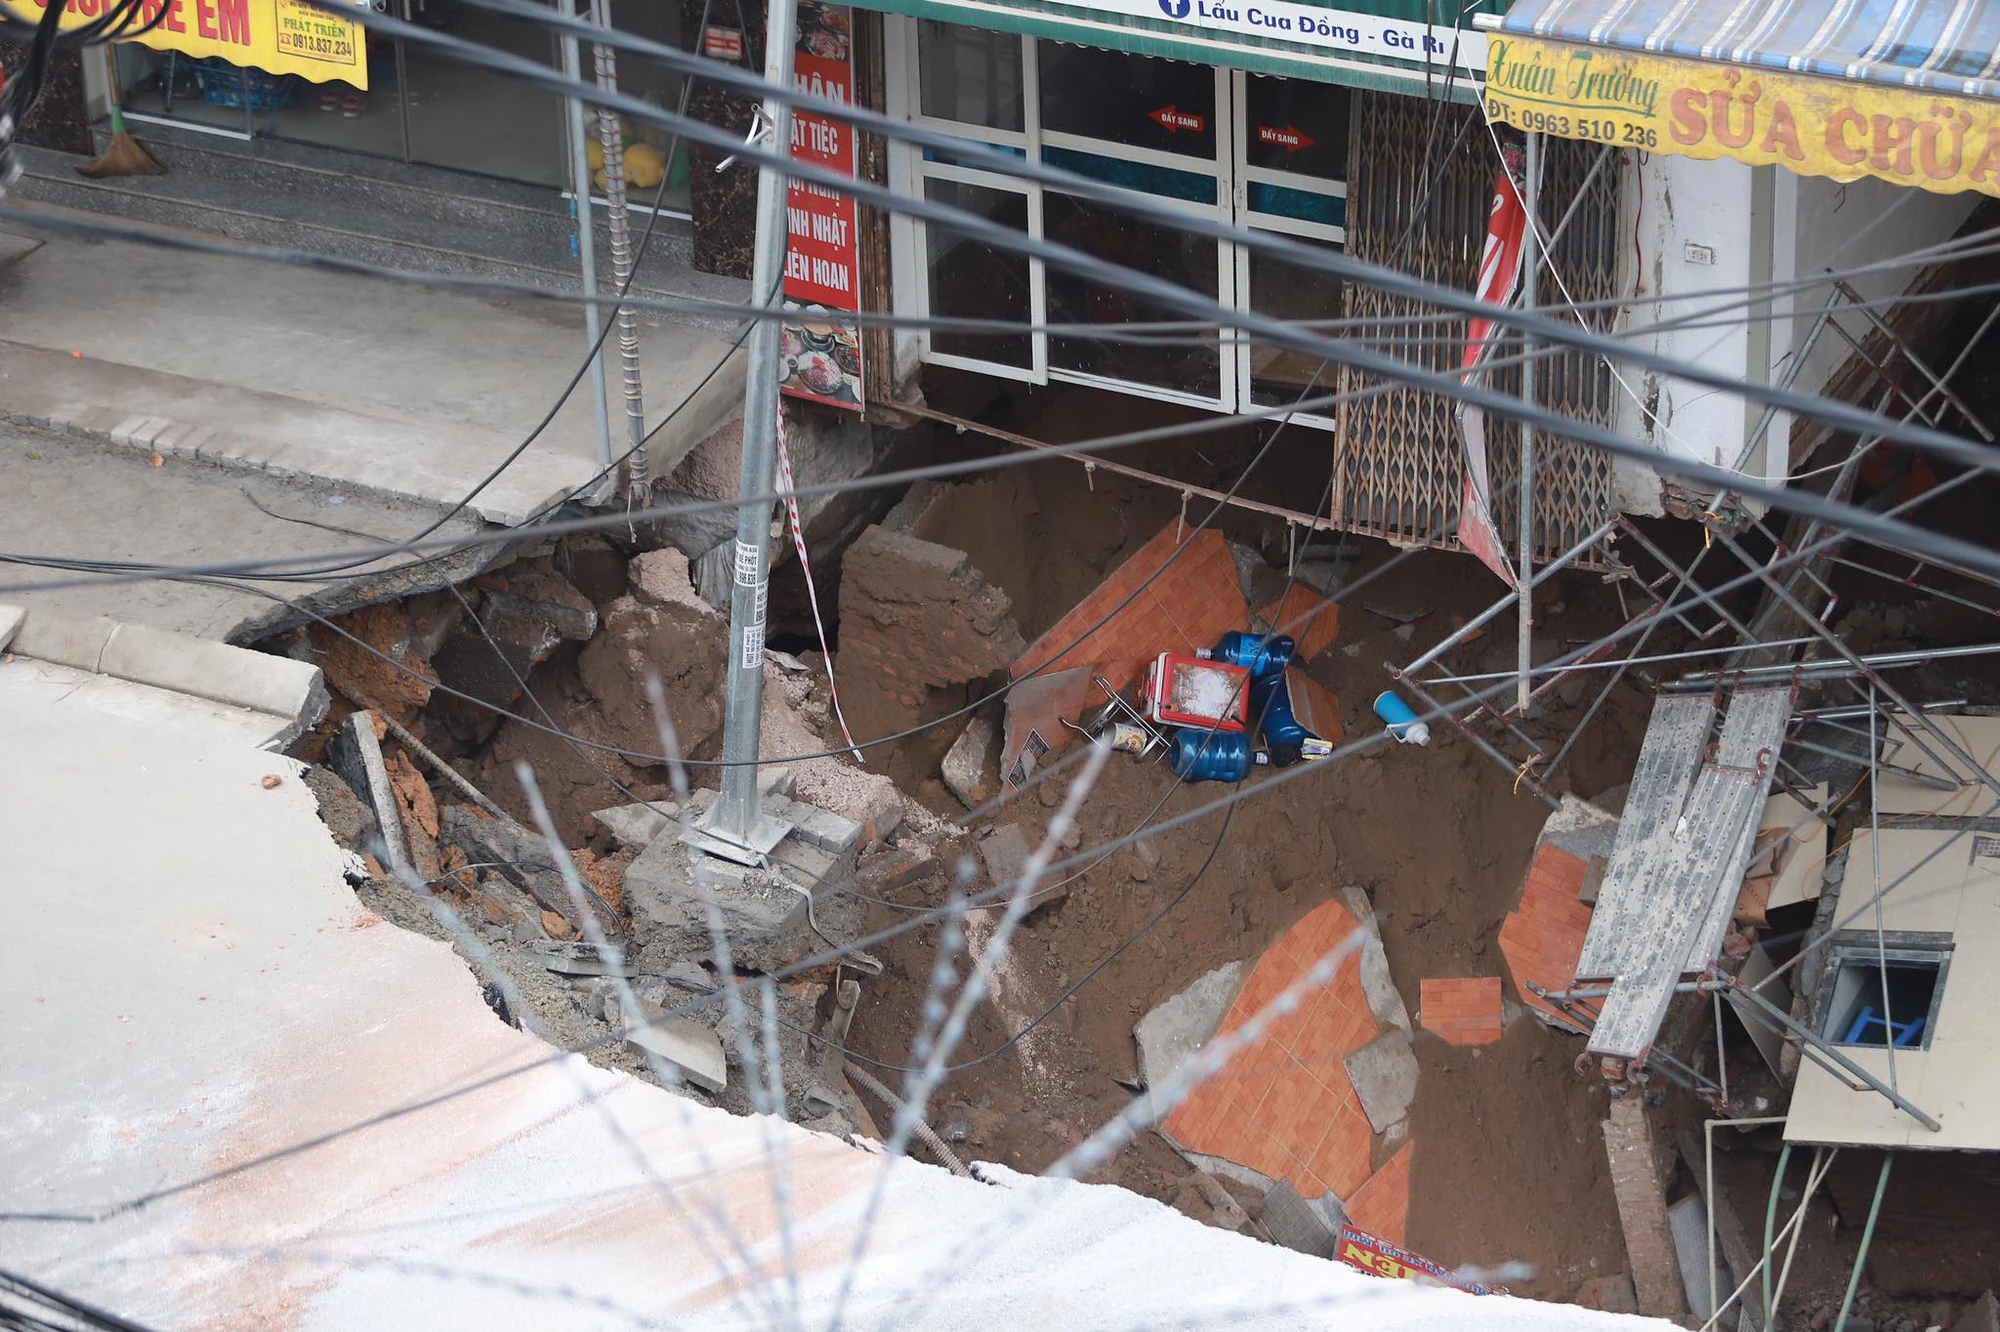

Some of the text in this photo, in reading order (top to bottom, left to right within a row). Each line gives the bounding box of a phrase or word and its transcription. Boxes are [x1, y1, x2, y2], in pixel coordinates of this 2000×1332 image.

[293, 33, 352, 57] 0913.837.234
[1247, 8, 1291, 31] Cua
[1299, 16, 1360, 45] Đồng
[1382, 28, 1415, 50] Gà
[1487, 39, 1556, 96] Xuân
[1177, 117, 1198, 128] SANG
[1488, 99, 1657, 148] ĐT: 0963 510 236
[1669, 66, 1806, 161] SỬA
[809, 120, 839, 159] TIỆC
[1277, 133, 1299, 145] SANG
[788, 206, 847, 251] INH NHẬT
[813, 256, 850, 293] HOAN
